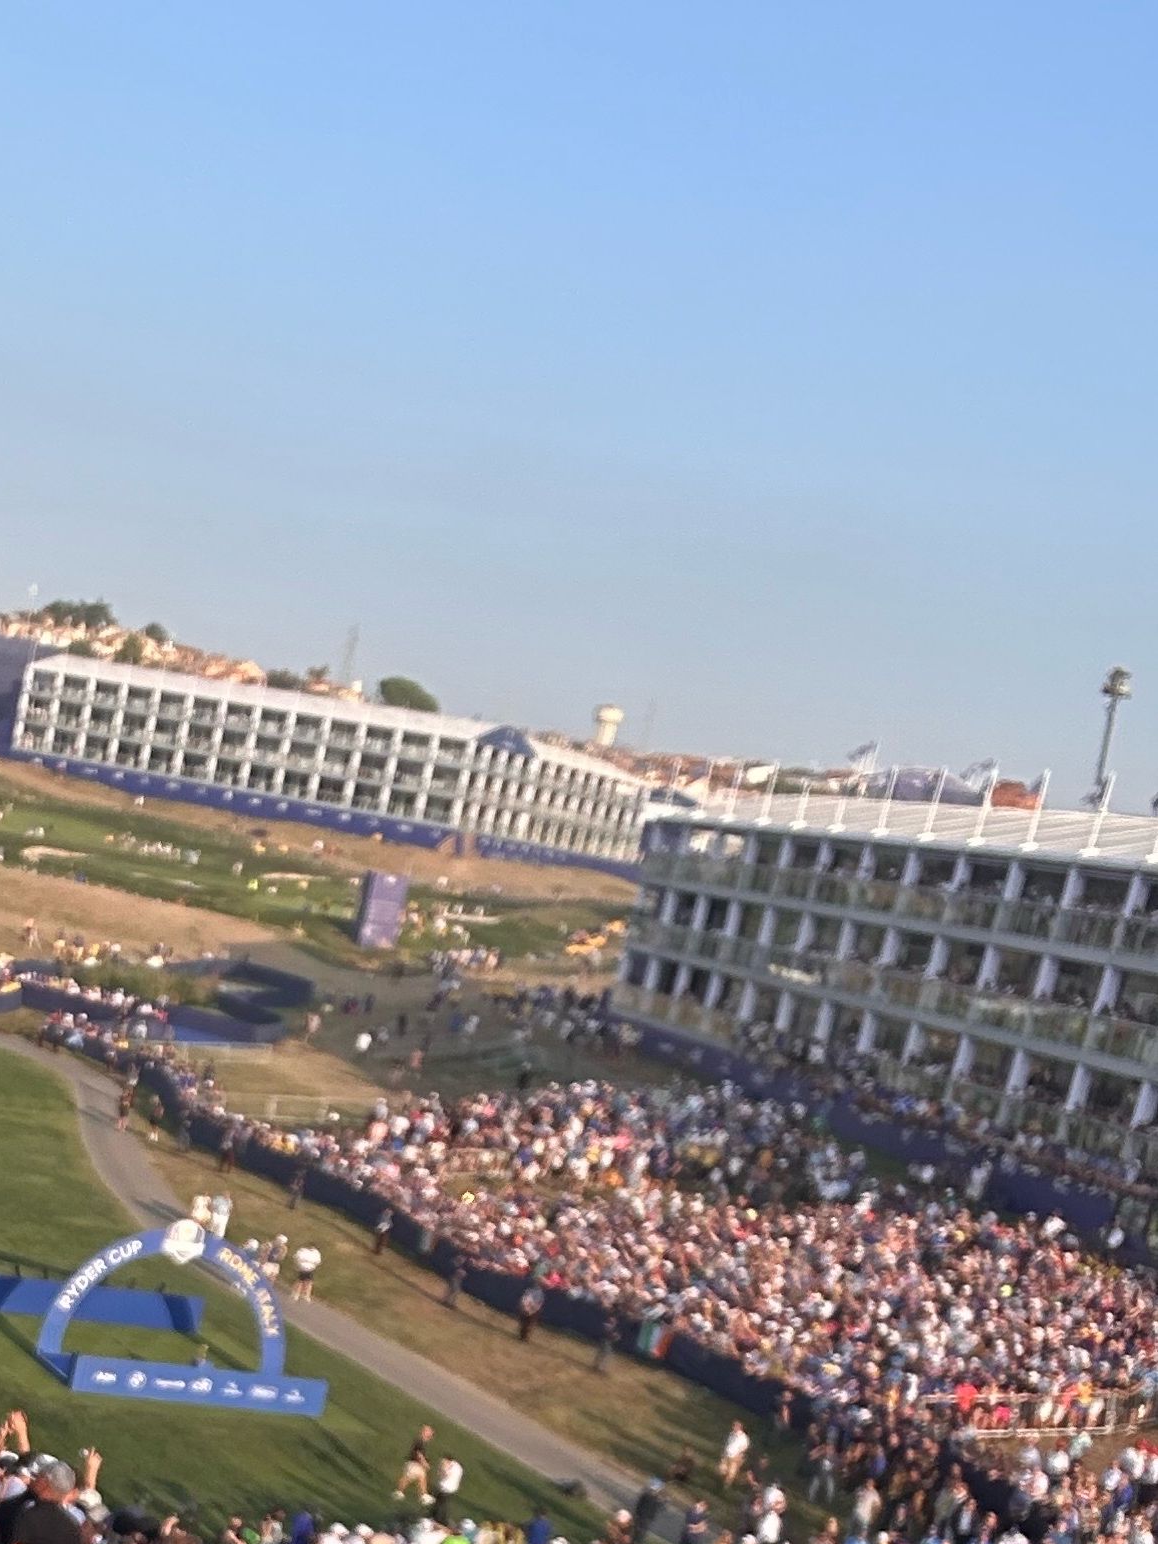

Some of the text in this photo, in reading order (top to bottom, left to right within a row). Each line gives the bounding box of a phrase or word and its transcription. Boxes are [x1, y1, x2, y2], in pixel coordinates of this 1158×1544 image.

[58, 1239, 143, 1310] RYDER CUP
[218, 1247, 260, 1286] ROME
